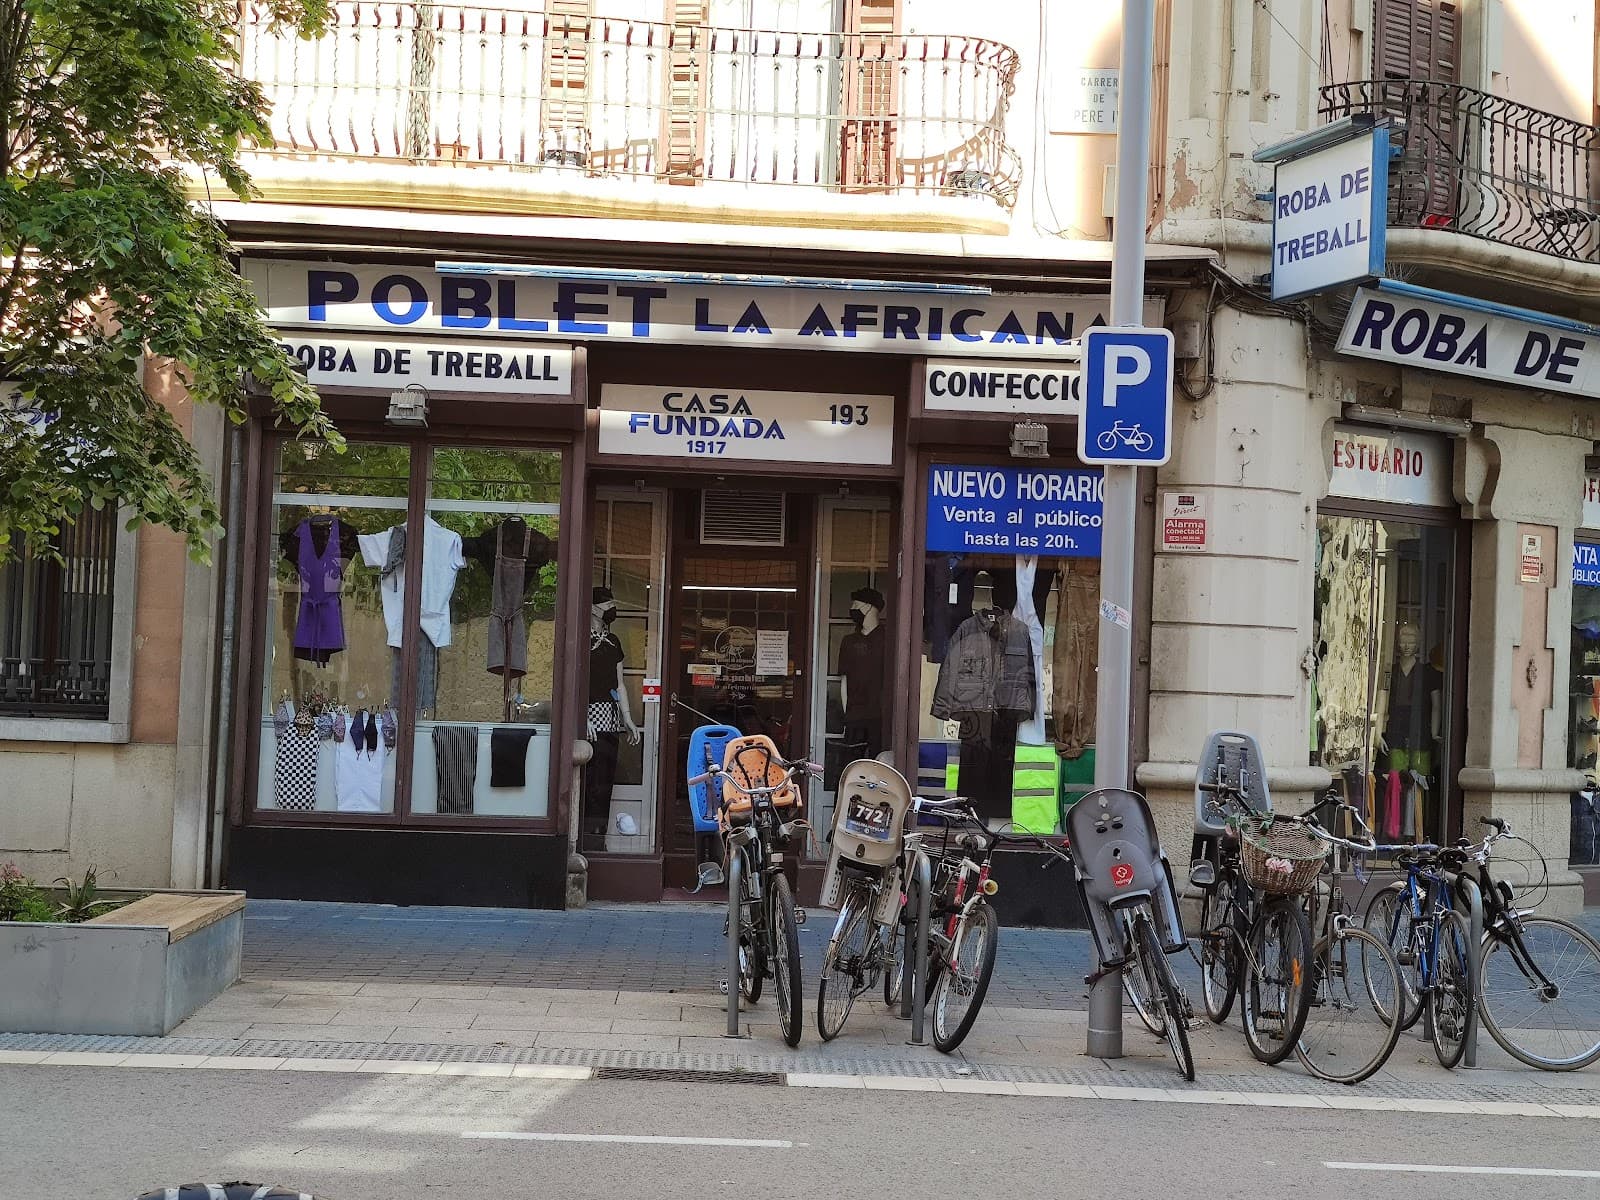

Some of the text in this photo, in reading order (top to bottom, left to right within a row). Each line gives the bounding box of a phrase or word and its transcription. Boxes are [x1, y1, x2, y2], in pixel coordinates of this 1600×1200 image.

[1080, 77, 1119, 87] CARRER
[1093, 93, 1105, 103] DE
[1074, 109, 1104, 123] PERE
[1278, 167, 1369, 220] ROBA DE
[1277, 219, 1368, 266] TREBALL
[307, 270, 667, 337] POBLET
[694, 297, 773, 335] LA
[1351, 299, 1586, 384] ROBA DE
[374, 348, 411, 375] DE
[427, 350, 559, 382] TREBALL
[1103, 344, 1151, 407] P
[662, 392, 752, 415] CASA
[829, 404, 869, 426] 193
[628, 413, 785, 440] FUNDADA
[686, 440, 726, 455] 1917
[1333, 439, 1423, 477] ESTUARIO
[933, 470, 1006, 500] NUEVO
[943, 505, 1102, 529] Venta al público
[1166, 519, 1204, 529] Alarma
[964, 531, 1079, 549] hasta las 20h.
[856, 804, 884, 823] 772
